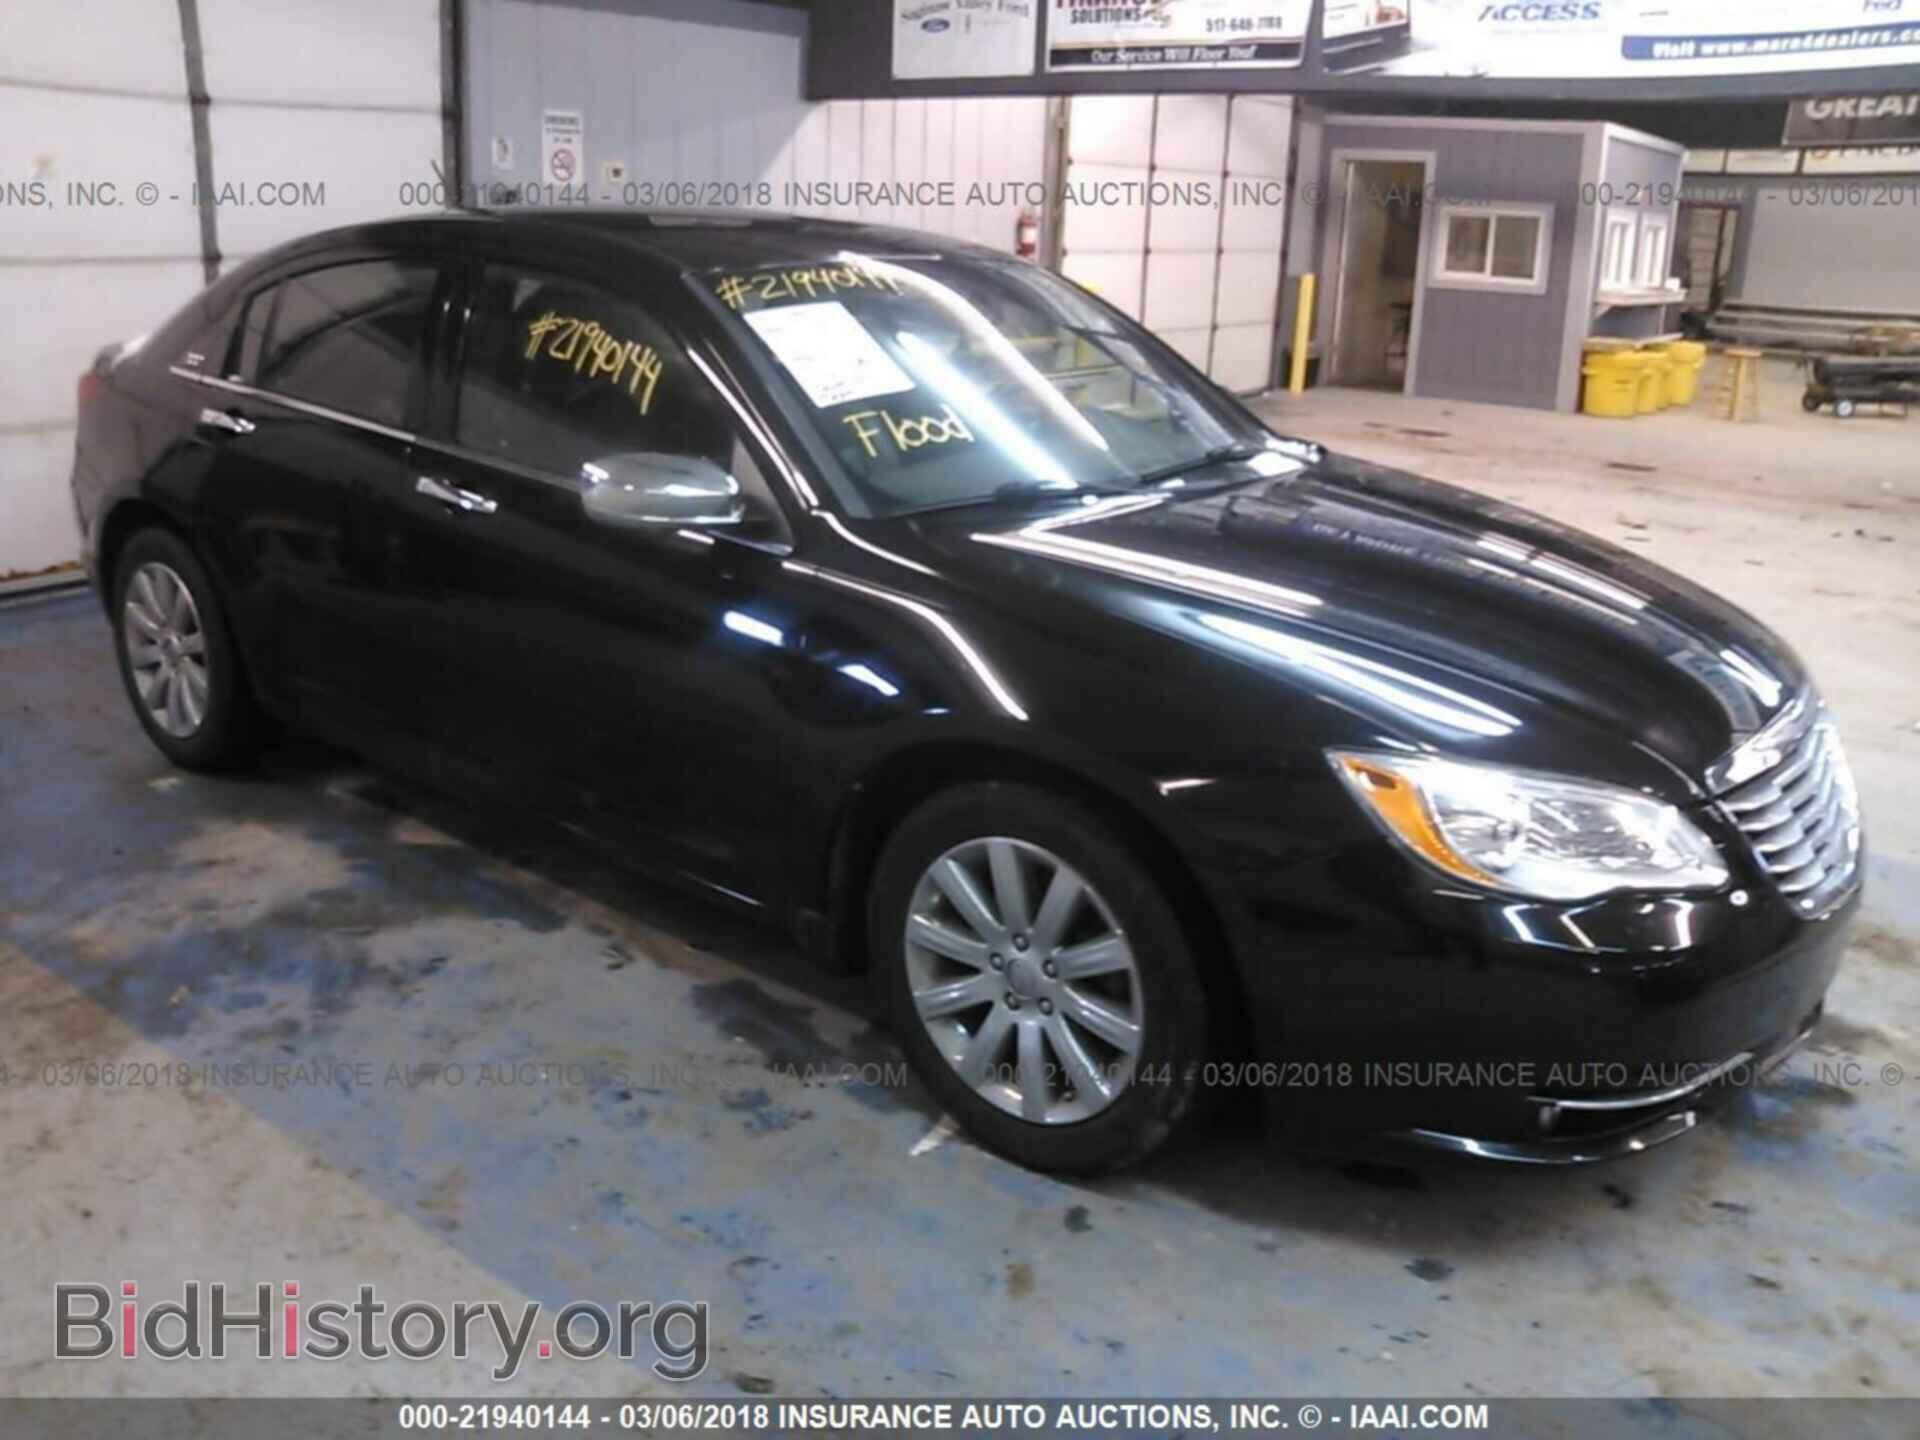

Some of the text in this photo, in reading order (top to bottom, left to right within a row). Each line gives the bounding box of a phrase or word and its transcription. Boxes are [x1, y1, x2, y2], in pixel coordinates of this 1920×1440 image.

[1069, 8, 1142, 25] SOLUTIONS
[1090, 49, 1113, 63] Our
[1116, 48, 1162, 63] Service
[524, 311, 664, 416] #21940144
[842, 402, 976, 458] Flood
